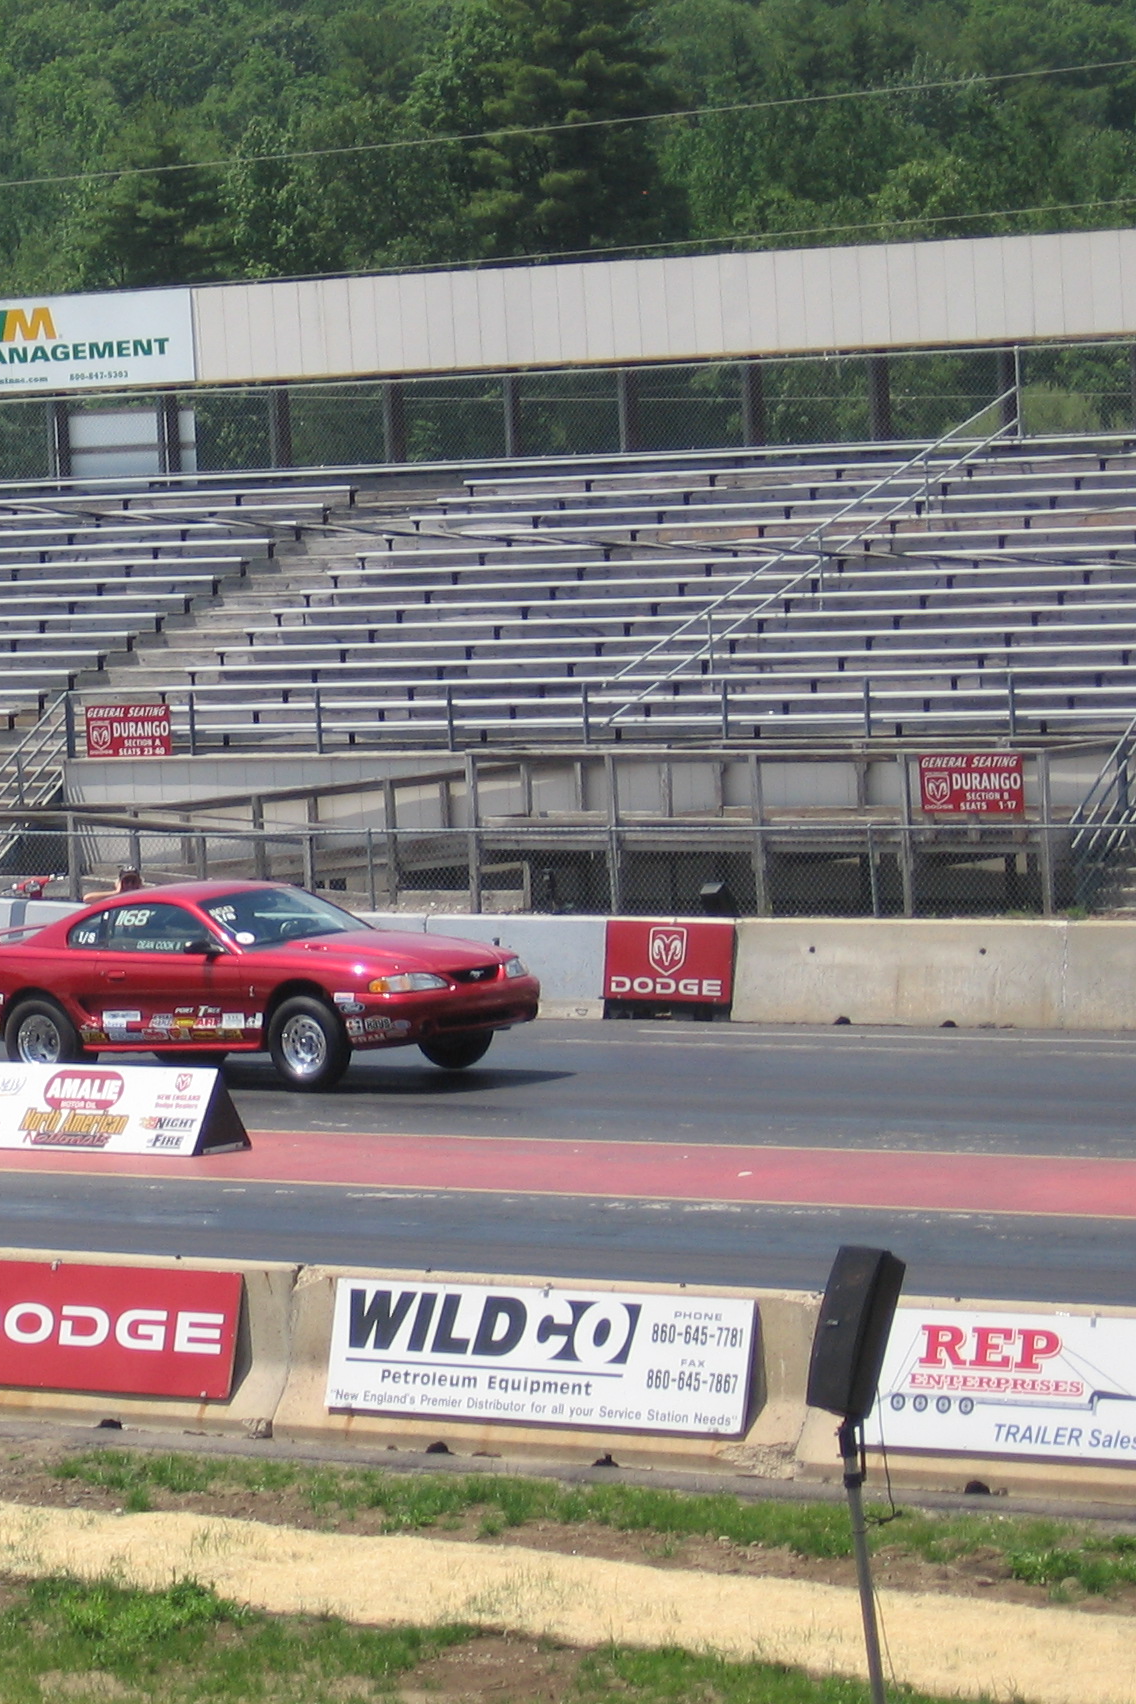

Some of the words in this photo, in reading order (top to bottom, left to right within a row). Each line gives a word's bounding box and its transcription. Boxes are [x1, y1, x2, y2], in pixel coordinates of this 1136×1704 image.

[87, 707, 124, 718] GENERAL
[128, 706, 166, 717] SEATING
[112, 720, 169, 738] DURANGO
[118, 747, 141, 756] SEATS
[124, 738, 152, 747] SECTION
[154, 738, 161, 746] A
[921, 756, 967, 768] GENERAL
[971, 756, 1018, 768] SEATING
[952, 773, 1021, 790] DURANGO
[966, 792, 1000, 801] SECTION
[960, 801, 987, 811] SEATS
[610, 976, 722, 996] DODGE
[46, 1078, 122, 1101] AMALIE
[18, 1107, 62, 1132] North
[59, 1108, 129, 1136] American
[154, 1117, 197, 1130] NIGHT
[151, 1133, 184, 1147] FIRE
[673, 1311, 723, 1322] PHONE
[348, 1288, 642, 1366] WILDCO
[651, 1322, 744, 1349] 860-645-7781
[918, 1324, 1063, 1374] REP
[680, 1358, 706, 1368] FAX
[381, 1368, 478, 1389] Petroleum
[487, 1375, 593, 1398] Equipment
[646, 1368, 739, 1395] 860-645-7867
[909, 1373, 1084, 1396] ENTERPRISES
[364, 1390, 415, 1406] England's
[420, 1394, 463, 1408] Premier
[467, 1397, 526, 1414] Distributor
[530, 1400, 547, 1415] for
[551, 1403, 564, 1415] all
[569, 1406, 594, 1418] your
[599, 1405, 642, 1420] Service
[647, 1408, 689, 1423] Station
[994, 1423, 1084, 1447] TRAILER
